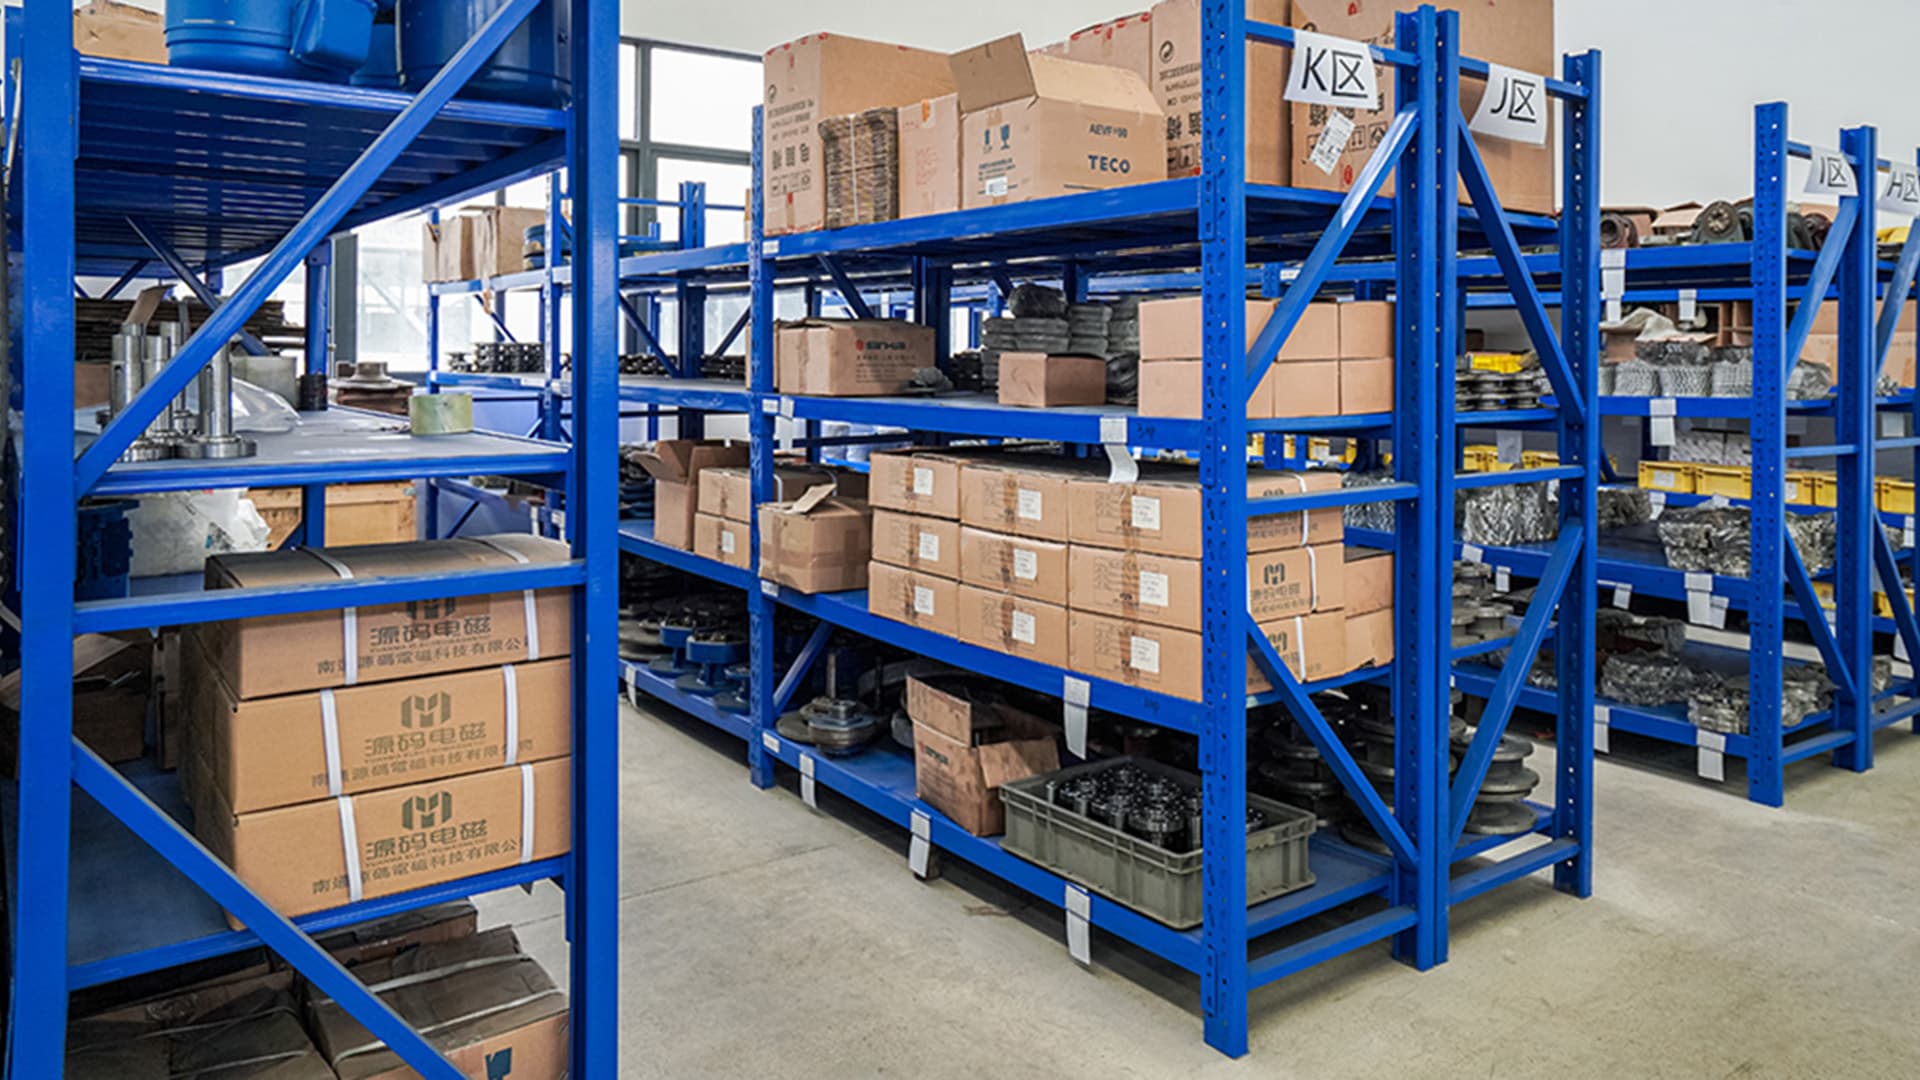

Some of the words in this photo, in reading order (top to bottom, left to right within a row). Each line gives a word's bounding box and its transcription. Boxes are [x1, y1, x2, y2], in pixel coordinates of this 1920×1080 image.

[1301, 46, 1368, 98] K区
[1490, 77, 1537, 124] J区
[1088, 154, 1131, 174] TECO
[370, 616, 491, 647] 源码电磁
[364, 722, 487, 757] 源码电磁
[365, 819, 488, 860] 源码电磁
